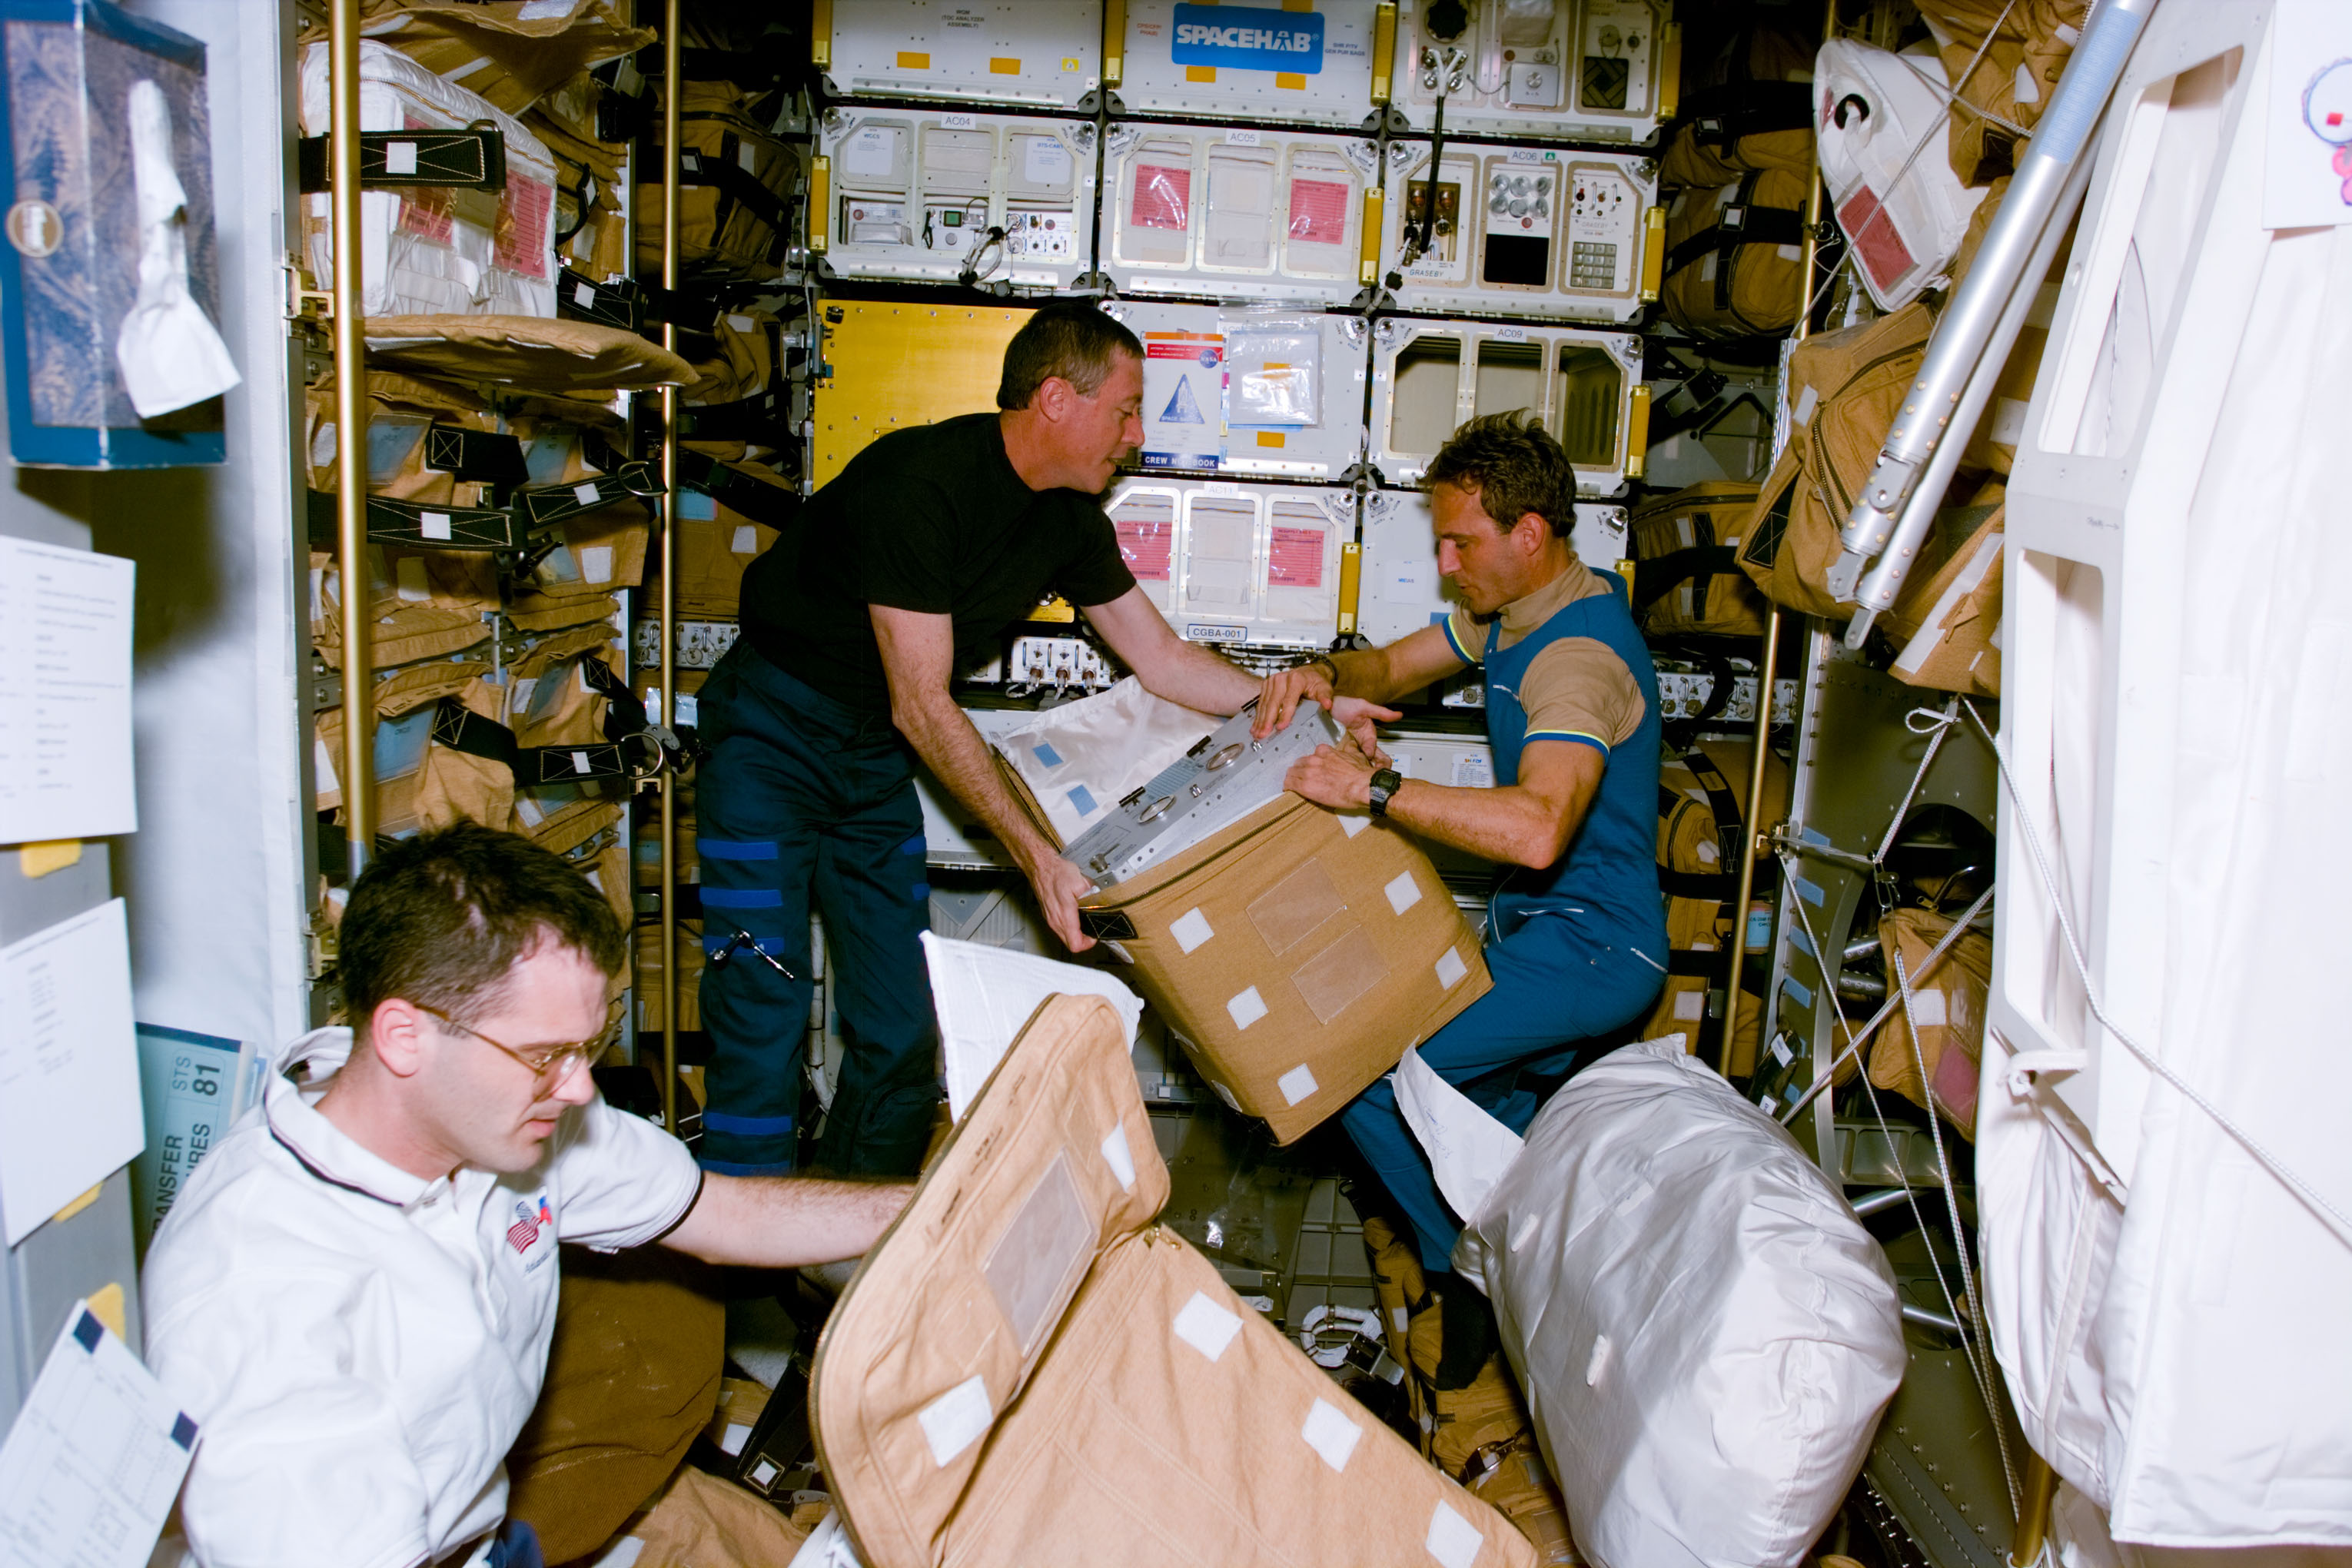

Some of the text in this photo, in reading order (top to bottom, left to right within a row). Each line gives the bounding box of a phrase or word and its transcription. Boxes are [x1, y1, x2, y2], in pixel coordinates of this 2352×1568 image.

[1176, 24, 1311, 52] SPACEHAB
[945, 116, 971, 126] AC04
[1230, 133, 1256, 143] AC05
[1512, 151, 1537, 161] AC06
[1409, 269, 1444, 277] GRASEBY
[1497, 328, 1523, 339] AC09
[1144, 456, 1168, 465] CREW
[1192, 627, 1241, 638] CGBA-001
[171, 1055, 192, 1092] STS
[192, 1063, 221, 1097] 81
